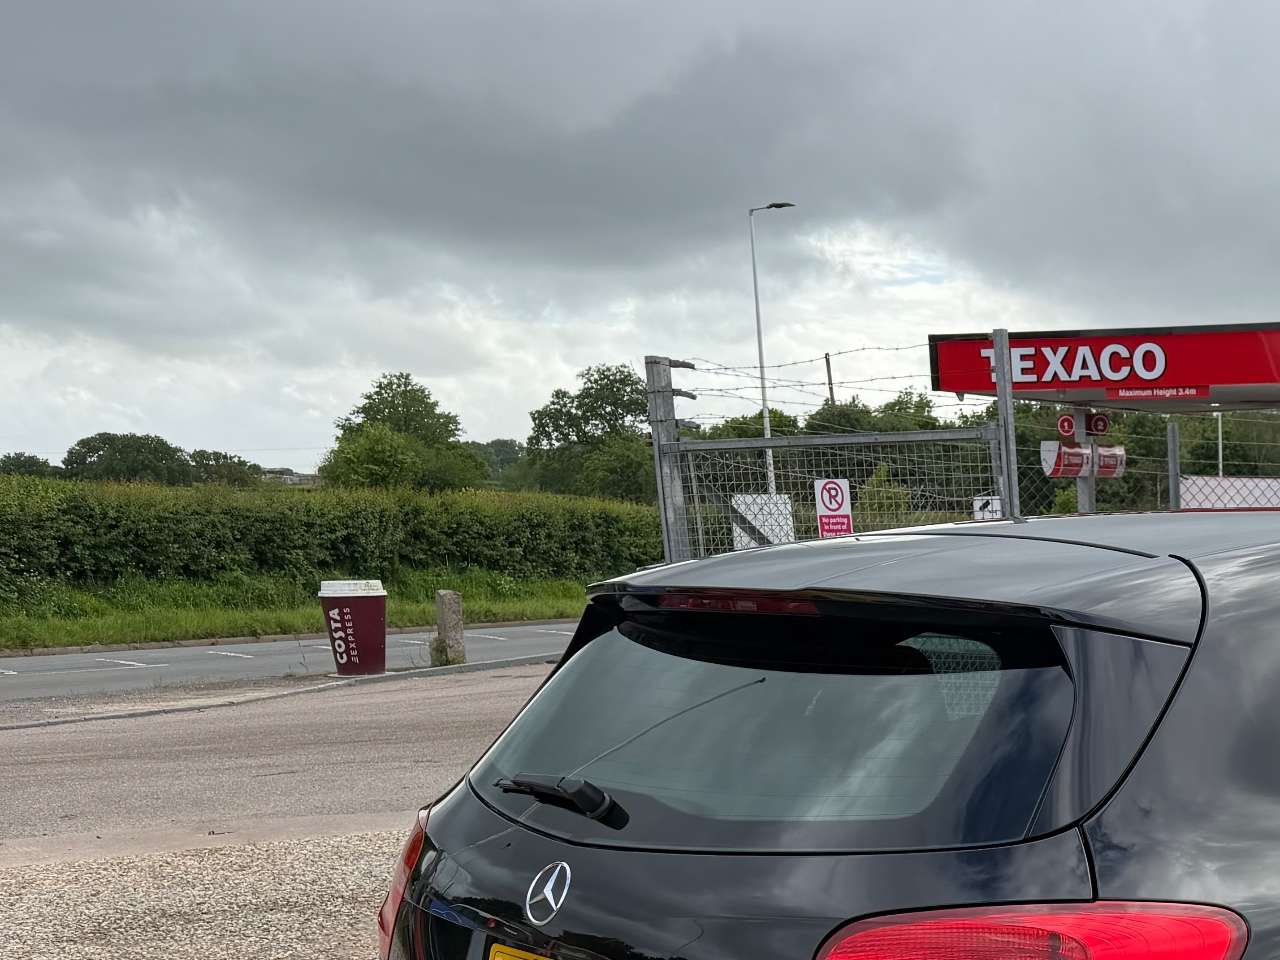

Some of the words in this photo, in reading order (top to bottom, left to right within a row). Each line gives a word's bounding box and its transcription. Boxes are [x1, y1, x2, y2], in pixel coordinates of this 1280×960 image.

[1119, 389, 1152, 397] Maximum
[1153, 387, 1177, 397] Height
[1178, 387, 1196, 395] 3.4m
[329, 608, 347, 664] COSTA
[343, 607, 358, 655] EXPRESS
